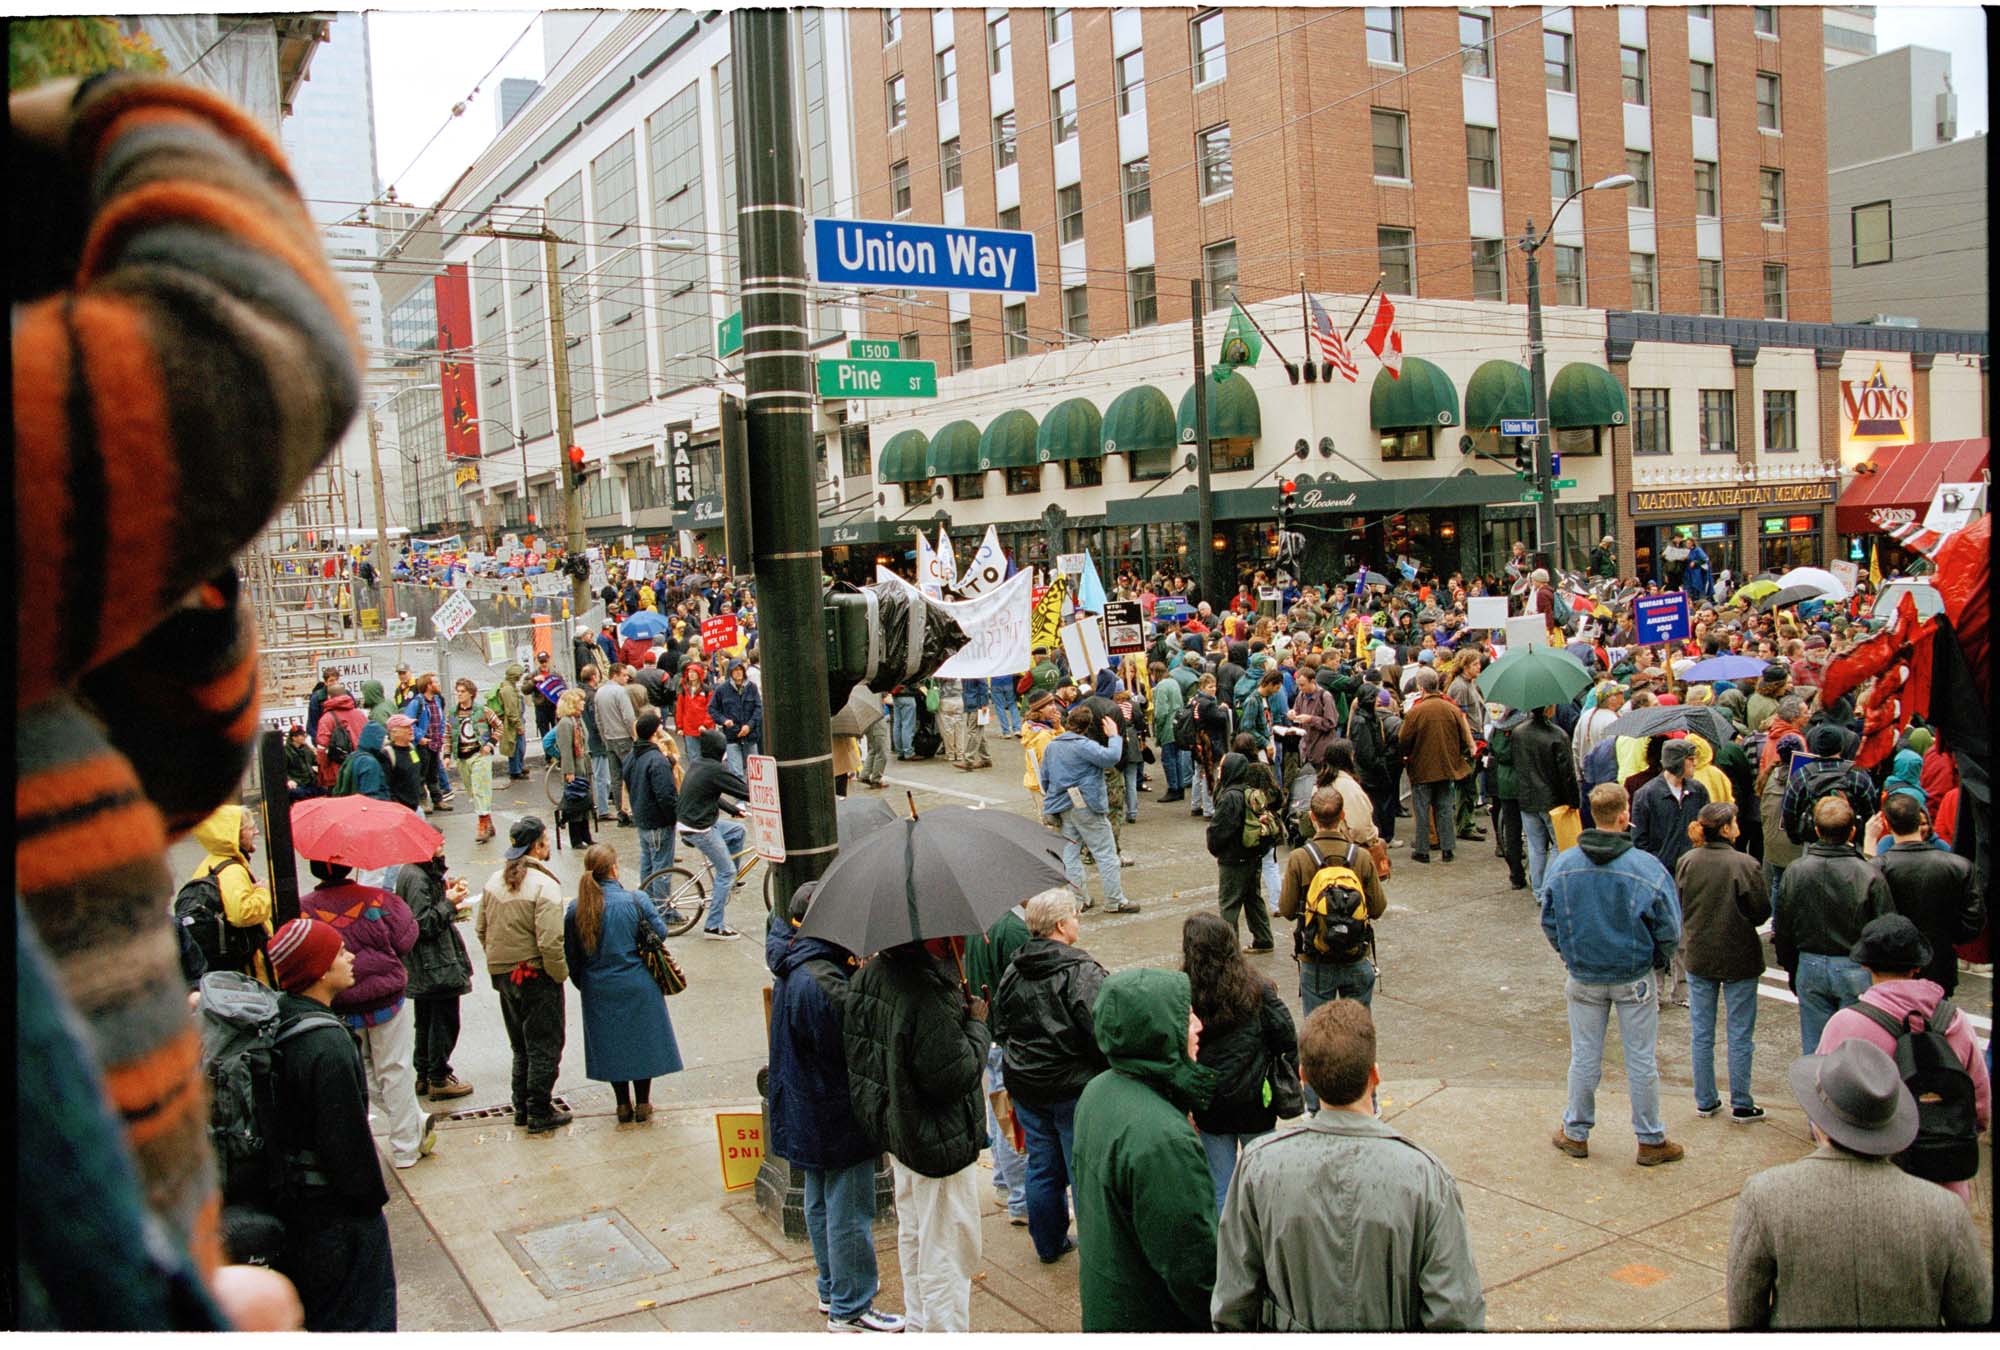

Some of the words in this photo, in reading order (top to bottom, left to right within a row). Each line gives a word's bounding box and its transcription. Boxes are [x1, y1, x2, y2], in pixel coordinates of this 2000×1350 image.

[836, 227, 936, 275] Union
[945, 233, 1017, 289] Way
[860, 344, 891, 360] 1500
[837, 364, 882, 390] Pine
[908, 376, 922, 391] ST
[1840, 380, 1908, 424] VON'S
[1504, 421, 1520, 430] Union
[1521, 421, 1535, 434] Way
[672, 430, 694, 502] PARK
[1298, 488, 1357, 509] Roosevelt
[1774, 484, 1833, 502] MEMORIAL
[957, 566, 999, 594] TO
[321, 663, 370, 677] SEWALK
[750, 758, 763, 780] NO
[728, 1146, 764, 1160] ING
